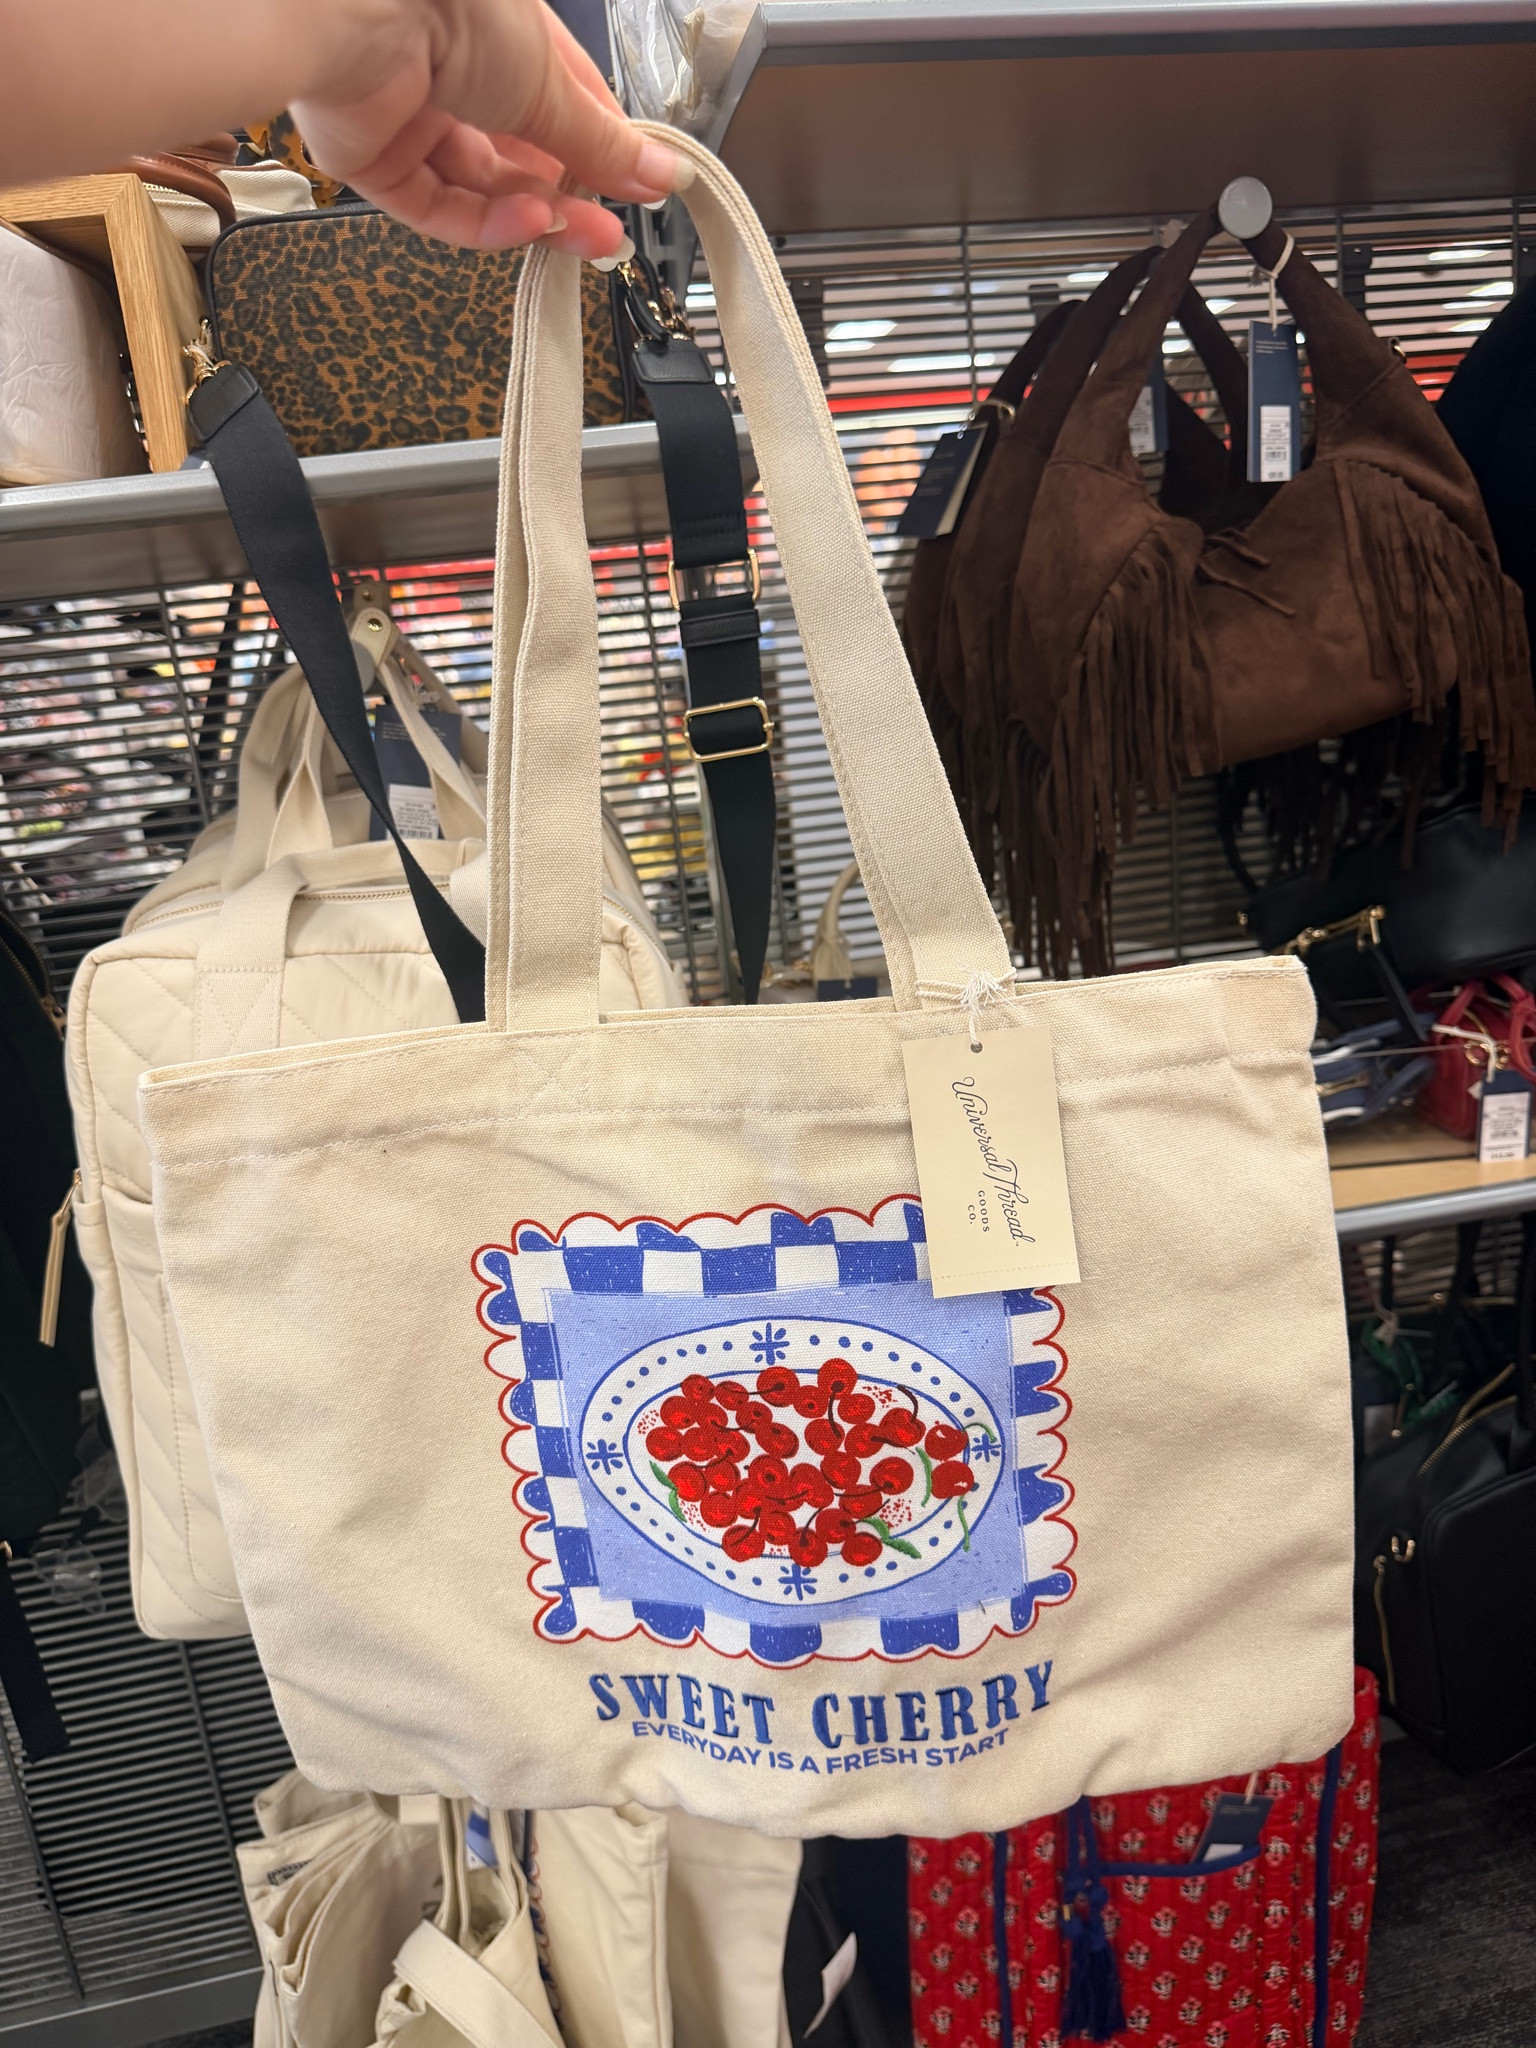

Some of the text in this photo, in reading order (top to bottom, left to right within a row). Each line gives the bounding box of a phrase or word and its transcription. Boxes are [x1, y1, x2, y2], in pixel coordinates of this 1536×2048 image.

[951, 1076, 1012, 1173] Universal
[967, 1204, 977, 1226] CO.
[977, 1190, 990, 1233] GOODS
[588, 1659, 1053, 1749] SWEET CHERRY
[631, 1721, 1009, 1775] EVERYDAY IS A FRESH START
